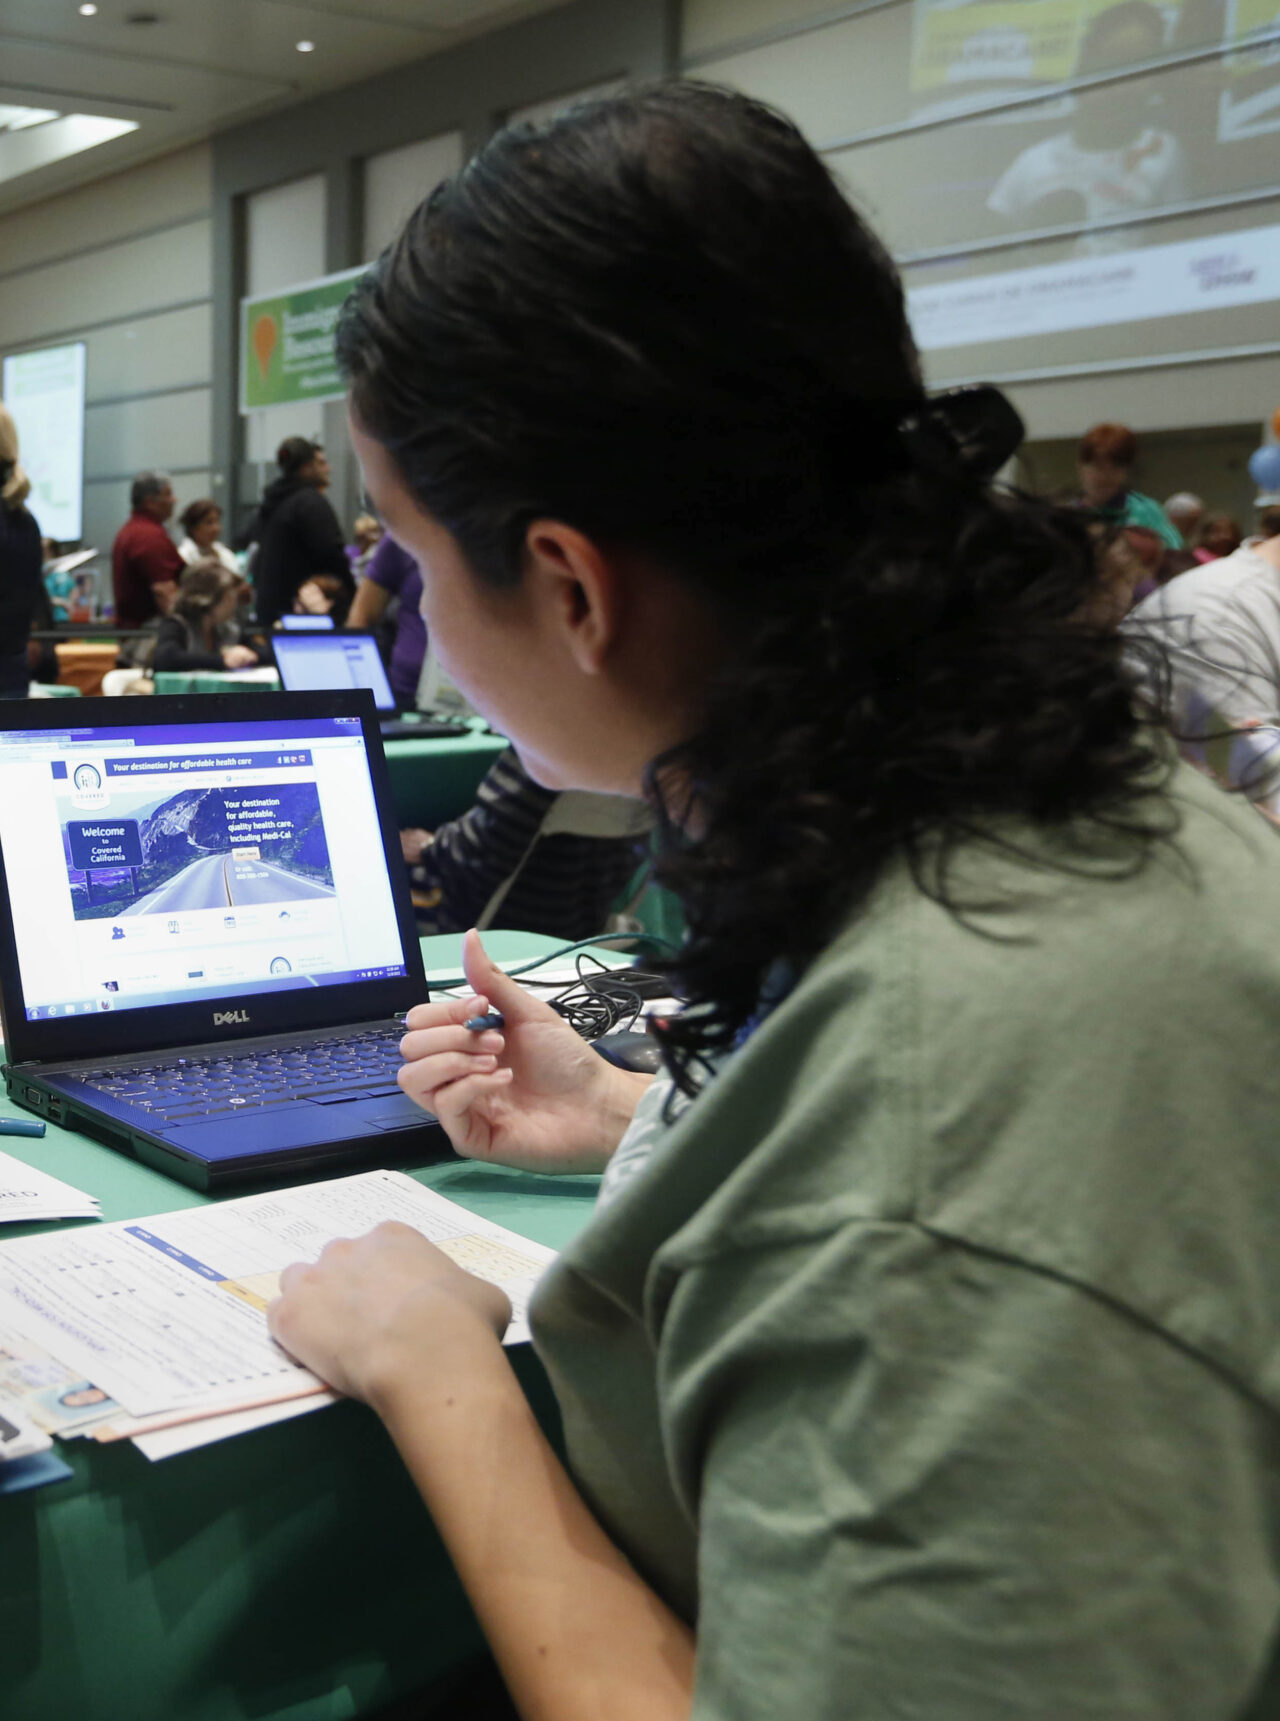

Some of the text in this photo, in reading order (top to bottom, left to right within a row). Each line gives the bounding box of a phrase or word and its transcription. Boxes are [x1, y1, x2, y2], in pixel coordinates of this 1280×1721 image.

[131, 762, 168, 770] destination
[169, 761, 179, 770] for
[181, 759, 214, 769] affordable
[216, 758, 236, 766] health
[242, 798, 280, 807] destination
[226, 810, 276, 820] for affordable,
[228, 822, 252, 832] quality
[253, 821, 275, 829] health
[82, 827, 125, 837] Welcome
[262, 831, 291, 840] Medi-Cal
[92, 846, 122, 854] Covered
[91, 854, 125, 863] California
[213, 1010, 250, 1025] DELL
